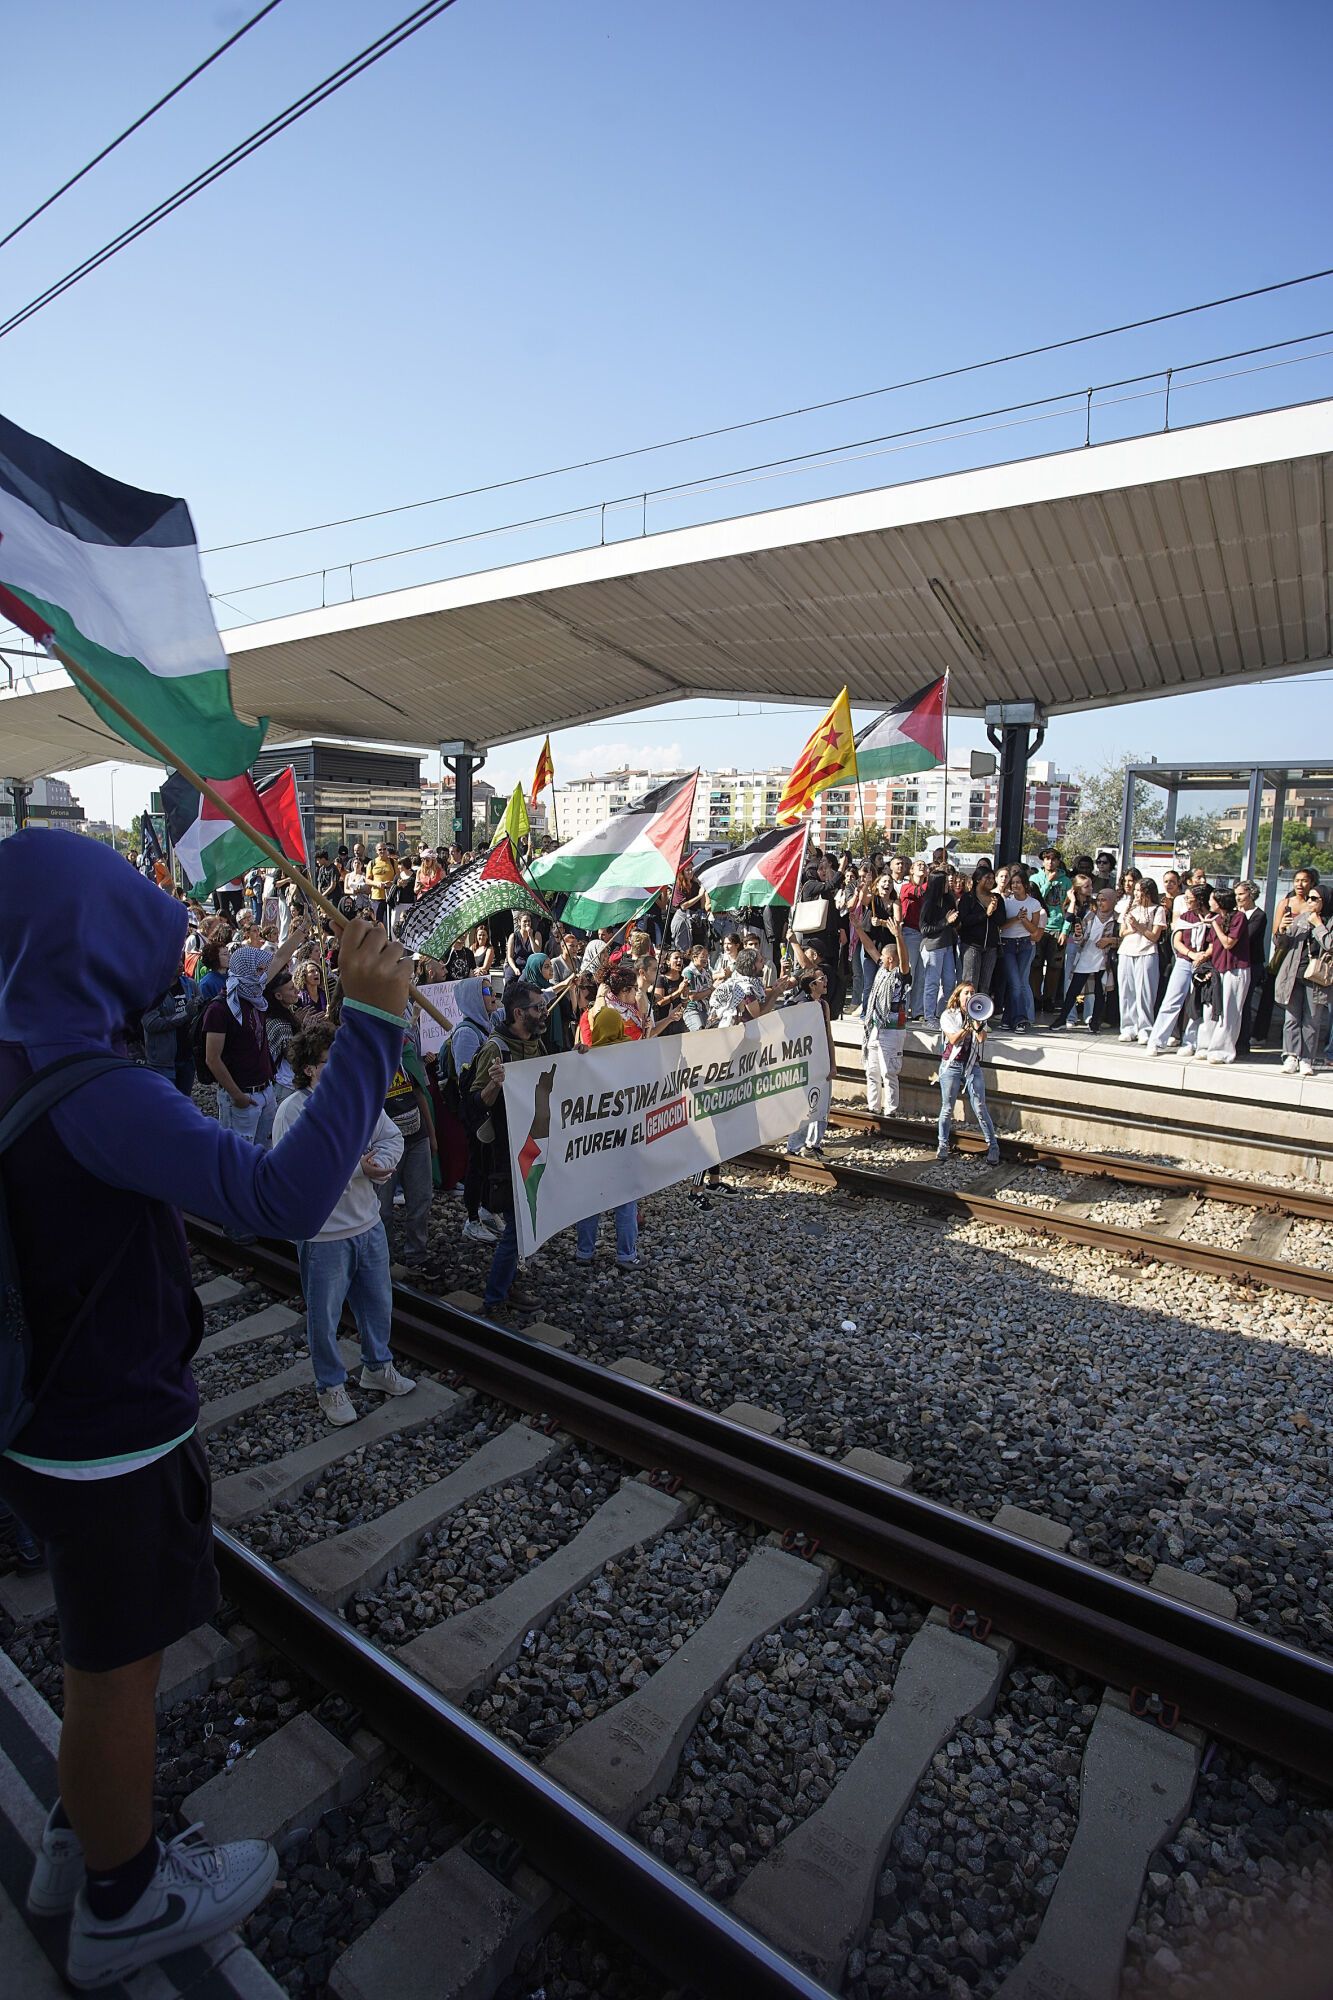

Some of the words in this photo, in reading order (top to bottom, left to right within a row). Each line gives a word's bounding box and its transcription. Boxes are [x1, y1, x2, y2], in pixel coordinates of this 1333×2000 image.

[561, 1080, 659, 1130] PALESTINA
[704, 1060, 735, 1085] DEL
[739, 1050, 758, 1077] RIU
[759, 1044, 777, 1068] AL
[782, 1035, 813, 1062] MAR
[565, 1128, 627, 1163] ATUREM
[631, 1122, 645, 1146] EL
[647, 1102, 687, 1138] GENOCIDI
[689, 1099, 692, 1119] I
[695, 1077, 753, 1116] L'OCUPACIÓ
[755, 1066, 807, 1095] COLONIAL
